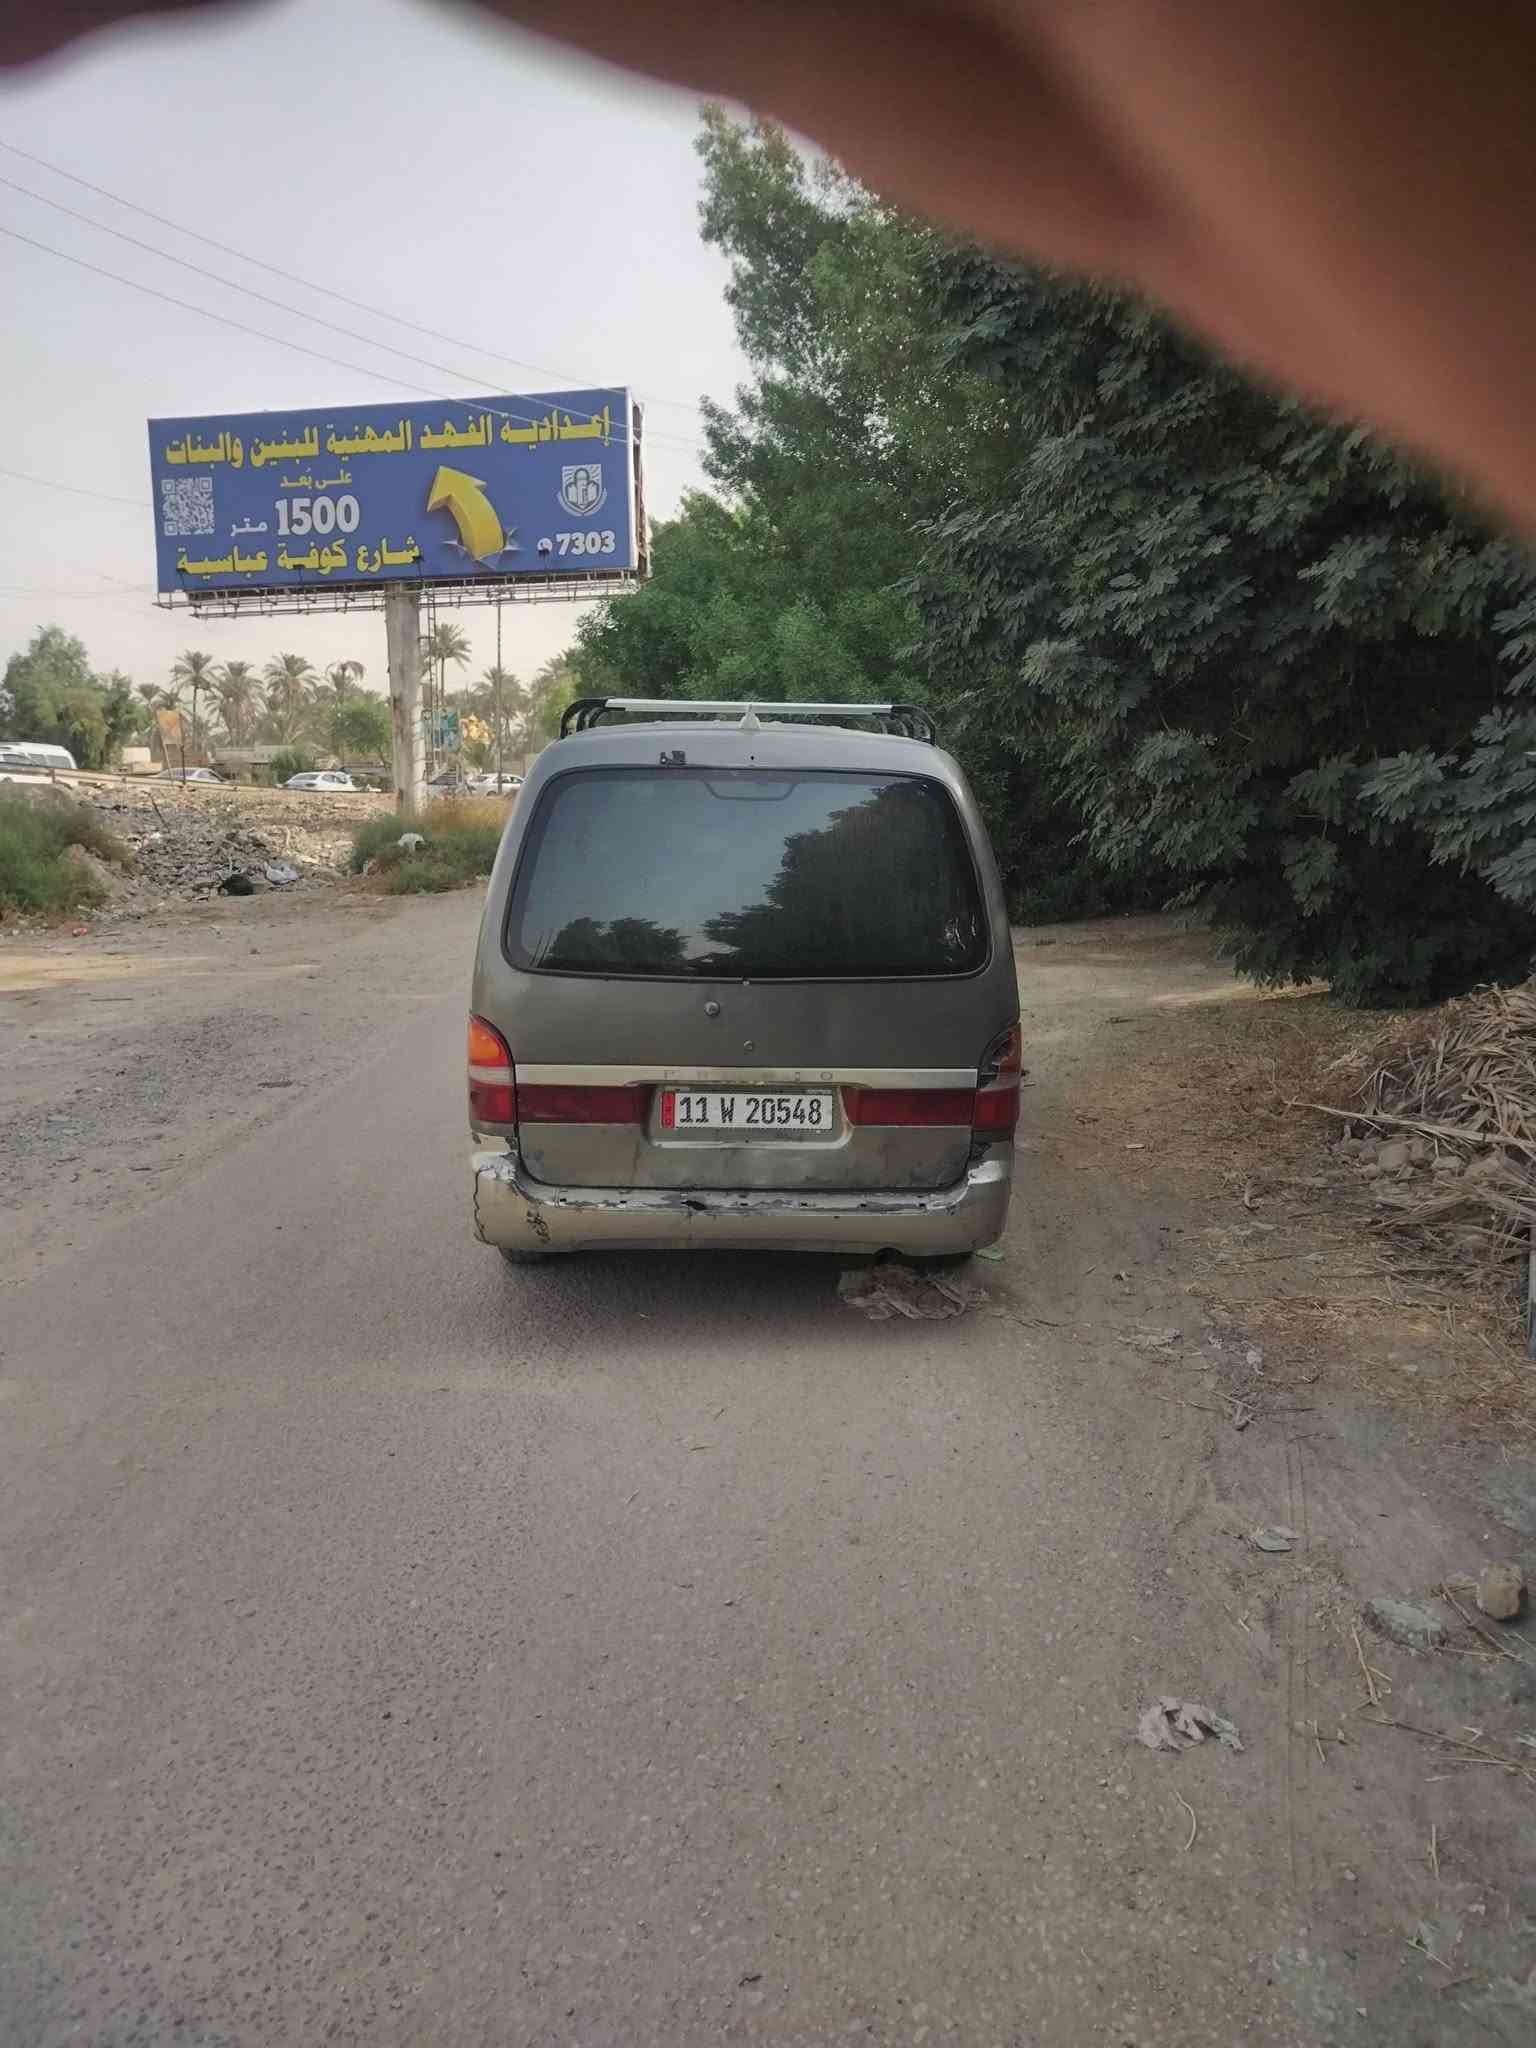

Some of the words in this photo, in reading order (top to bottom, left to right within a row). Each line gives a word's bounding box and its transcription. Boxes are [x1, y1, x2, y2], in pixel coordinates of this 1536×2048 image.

[250, 426, 320, 468] للبنين
[326, 419, 411, 461] المهنية
[420, 413, 492, 449] الفهد
[501, 406, 609, 451] إعدادية
[166, 431, 244, 469] والبنات
[315, 469, 352, 489] على
[230, 517, 268, 537] متر
[274, 494, 360, 536] 1500
[277, 538, 348, 575] كوفة
[356, 536, 421, 573] شارع
[555, 530, 616, 556] 7303
[176, 545, 269, 580] عباسية
[679, 1096, 709, 1124] 11
[720, 1096, 735, 1124] W
[745, 1097, 822, 1125] 20548
